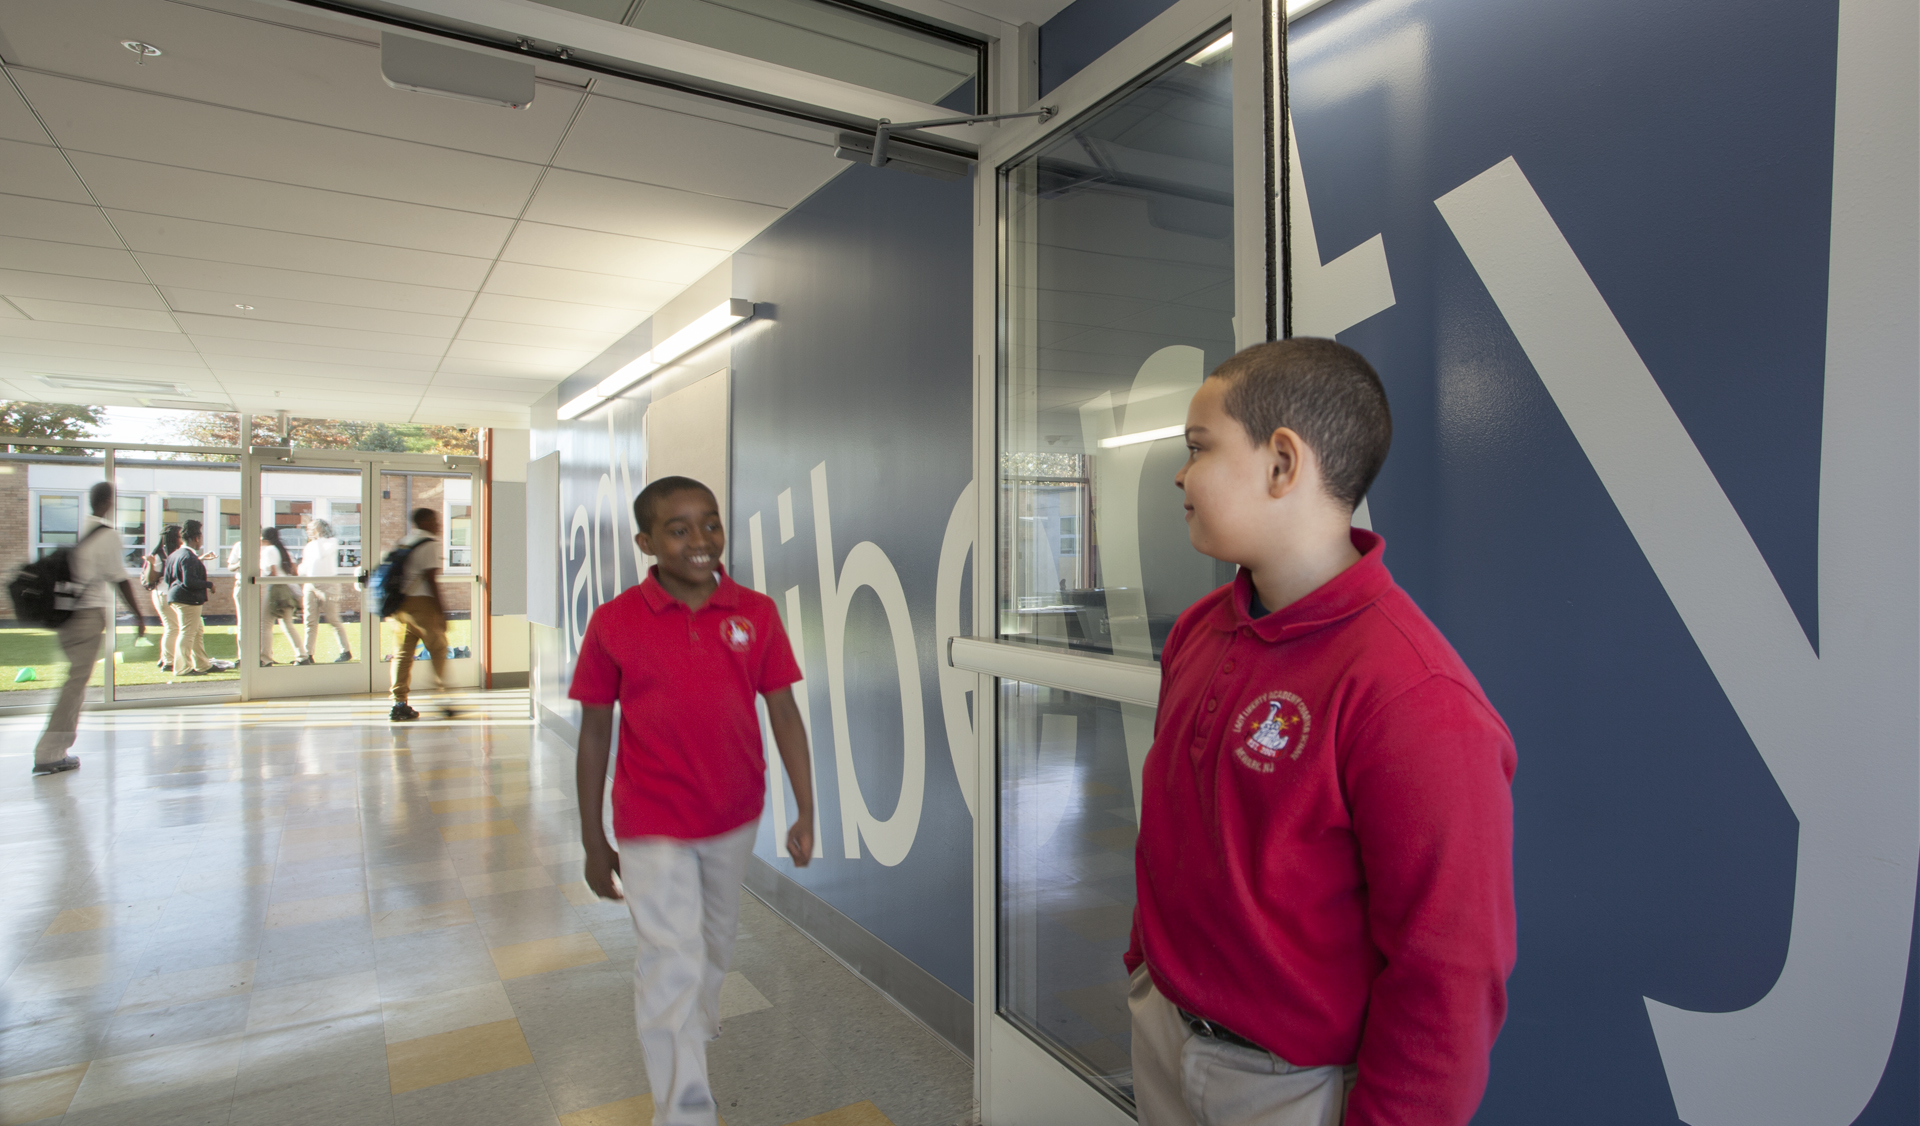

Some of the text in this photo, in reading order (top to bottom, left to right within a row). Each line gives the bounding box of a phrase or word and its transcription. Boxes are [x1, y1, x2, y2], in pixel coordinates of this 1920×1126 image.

[1233, 714, 1246, 733] LADY
[1243, 693, 1268, 717] LIBERTY
[1268, 690, 1302, 705] ACADEMY
[1262, 762, 1275, 773] NJ
